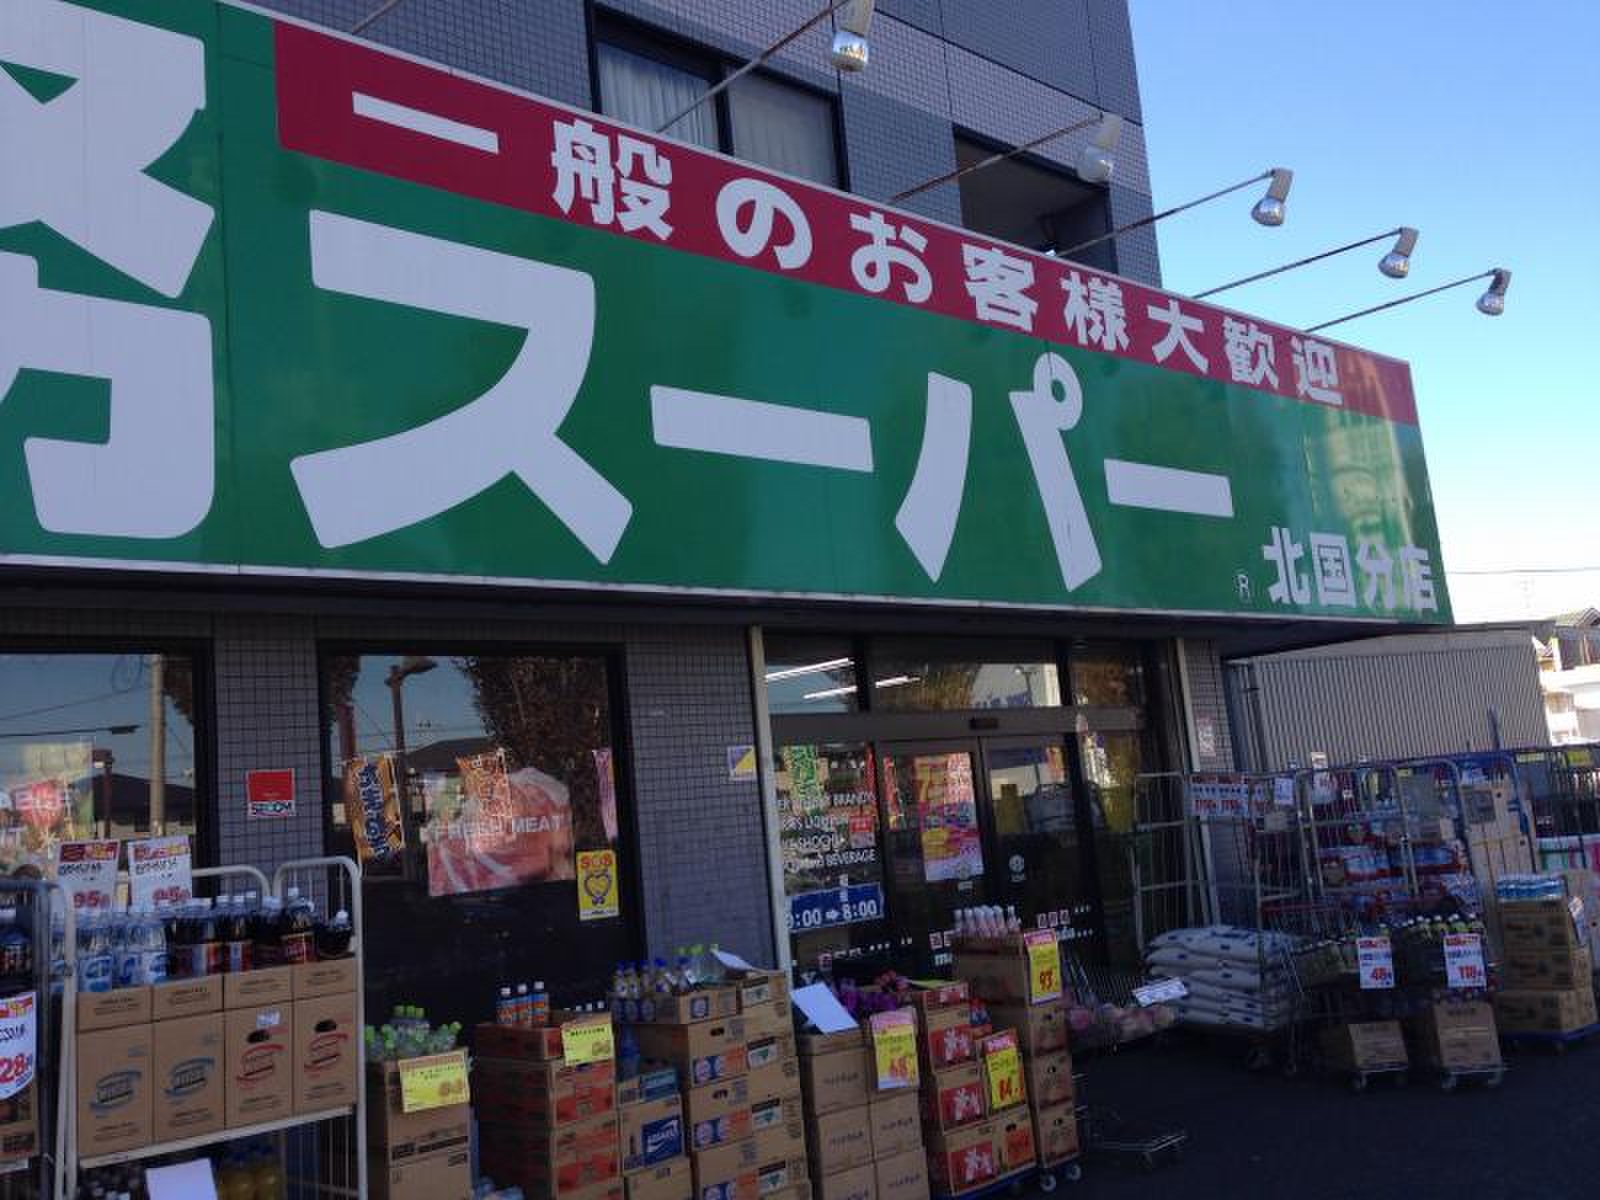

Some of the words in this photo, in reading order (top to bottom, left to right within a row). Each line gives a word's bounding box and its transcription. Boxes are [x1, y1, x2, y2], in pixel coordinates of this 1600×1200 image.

[352, 92, 1343, 406] 一般のお客様大歓迎
[1261, 525, 1438, 612] 北国分店
[511, 815, 562, 833] MEAT
[841, 898, 878, 921] 8:00
